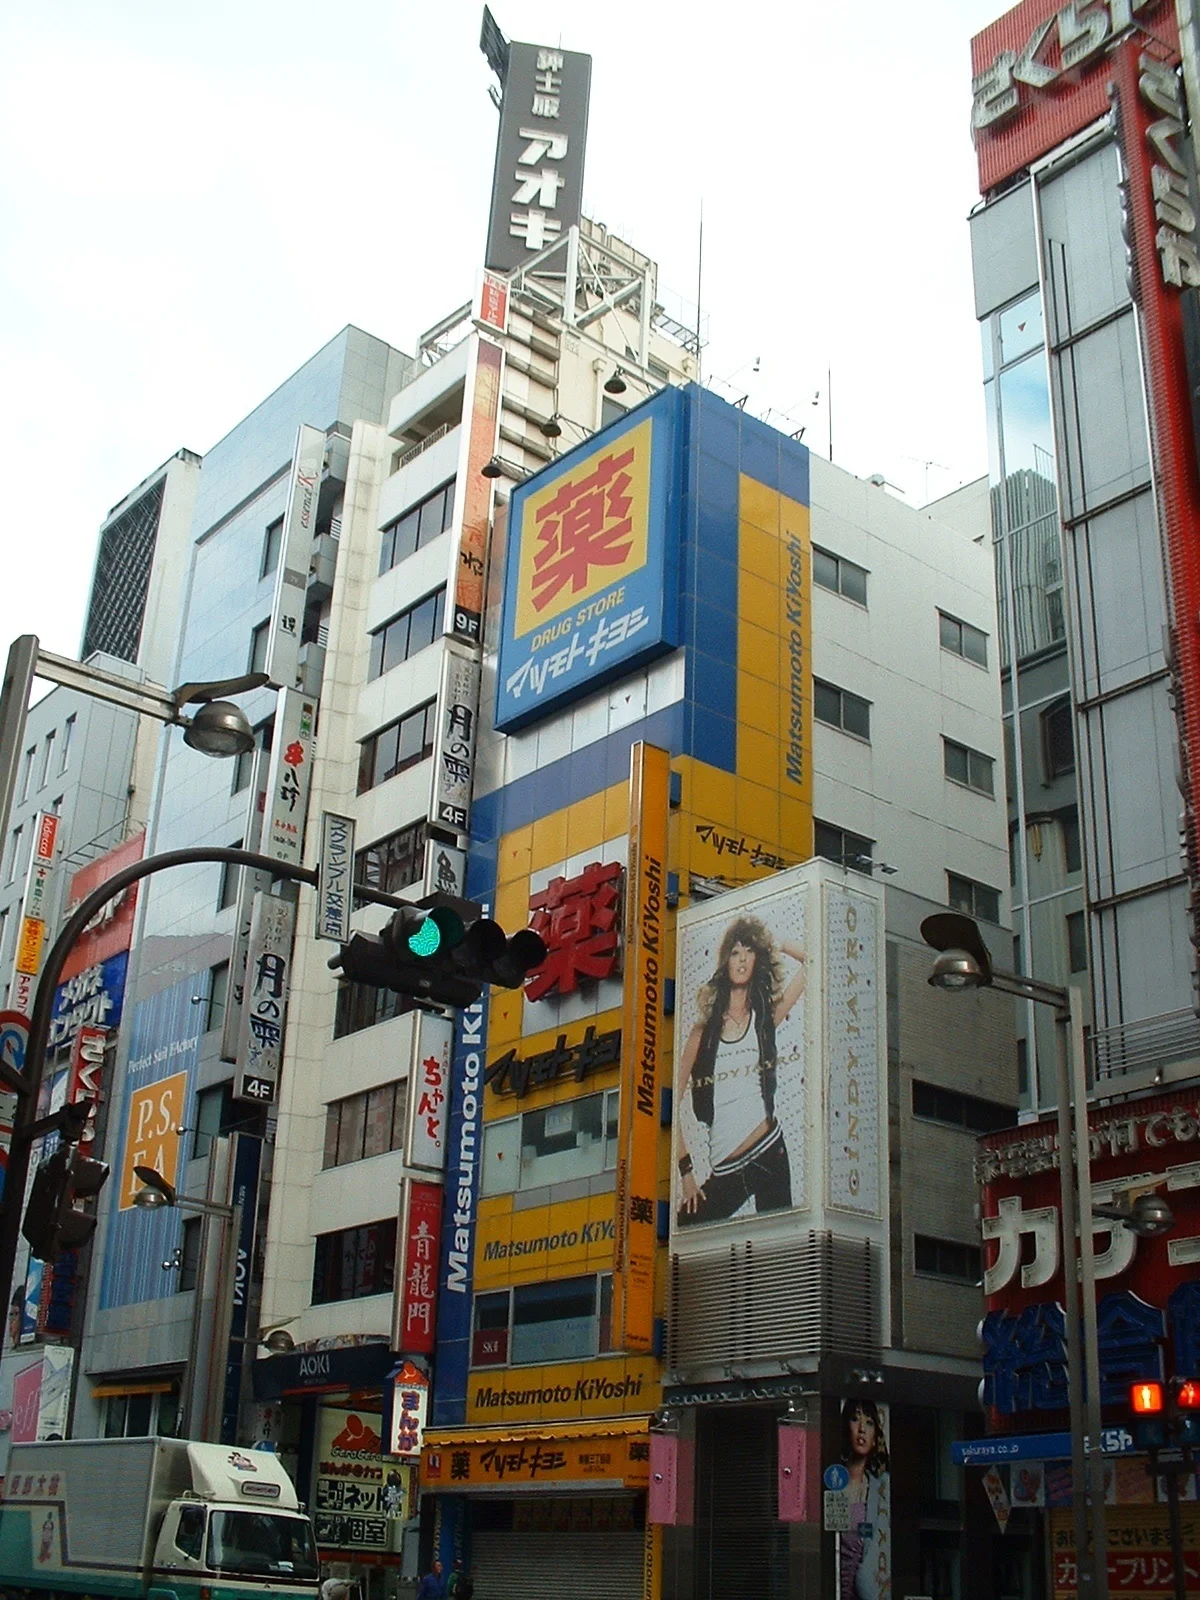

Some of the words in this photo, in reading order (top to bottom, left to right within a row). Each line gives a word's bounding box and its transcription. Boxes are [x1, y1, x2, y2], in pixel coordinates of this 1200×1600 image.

[509, 127, 569, 250] アオキ
[531, 446, 635, 613] 薬
[785, 529, 806, 628] KiYoshi
[455, 611, 480, 633] 9F
[505, 604, 651, 700] マツモトキヨシ
[530, 617, 574, 654] DRUG
[575, 585, 629, 630] STORE
[442, 703, 474, 784] 月の雫
[784, 629, 805, 787] Matsumoto
[441, 805, 465, 824] 4F
[522, 861, 624, 1003] 薬
[642, 855, 662, 956] KiYoshi
[248, 952, 287, 1048] 月の雫
[637, 958, 660, 1118] Matsumoto
[247, 1079, 271, 1099] 4F
[484, 1026, 623, 1100] マツモトキヨ
[135, 1089, 178, 1145] P.S.
[447, 1051, 481, 1293] Matsumoto
[406, 1220, 435, 1336] 青龍門
[483, 1230, 579, 1261] Matsumoto
[581, 1217, 616, 1245] KiYo
[299, 1354, 331, 1377] AOKI
[475, 1384, 572, 1411] Matsumoto
[574, 1373, 643, 1402] KiYoshi
[451, 1450, 471, 1480] 薬
[480, 1445, 567, 1479] マツモトキヨシ
